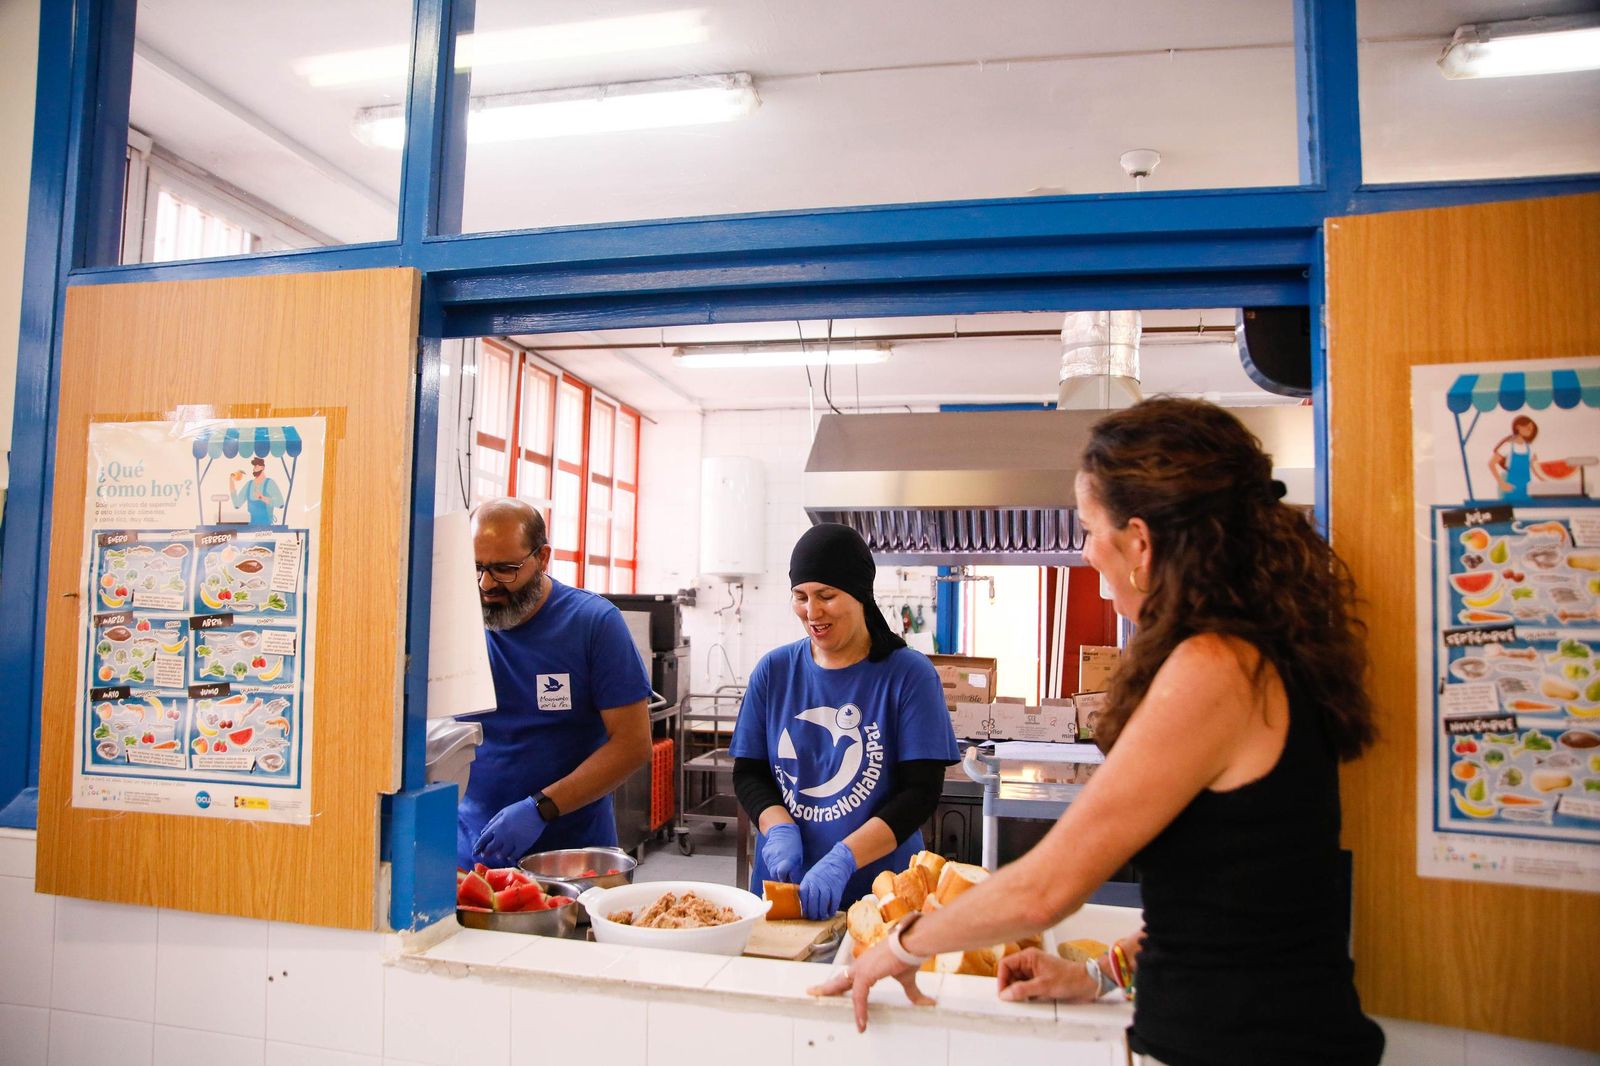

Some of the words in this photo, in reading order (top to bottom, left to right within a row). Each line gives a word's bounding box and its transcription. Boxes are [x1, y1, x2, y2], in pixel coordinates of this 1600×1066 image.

[98, 459, 144, 483] ¿Qué
[96, 484, 146, 497] como
[151, 479, 192, 501] hoy?
